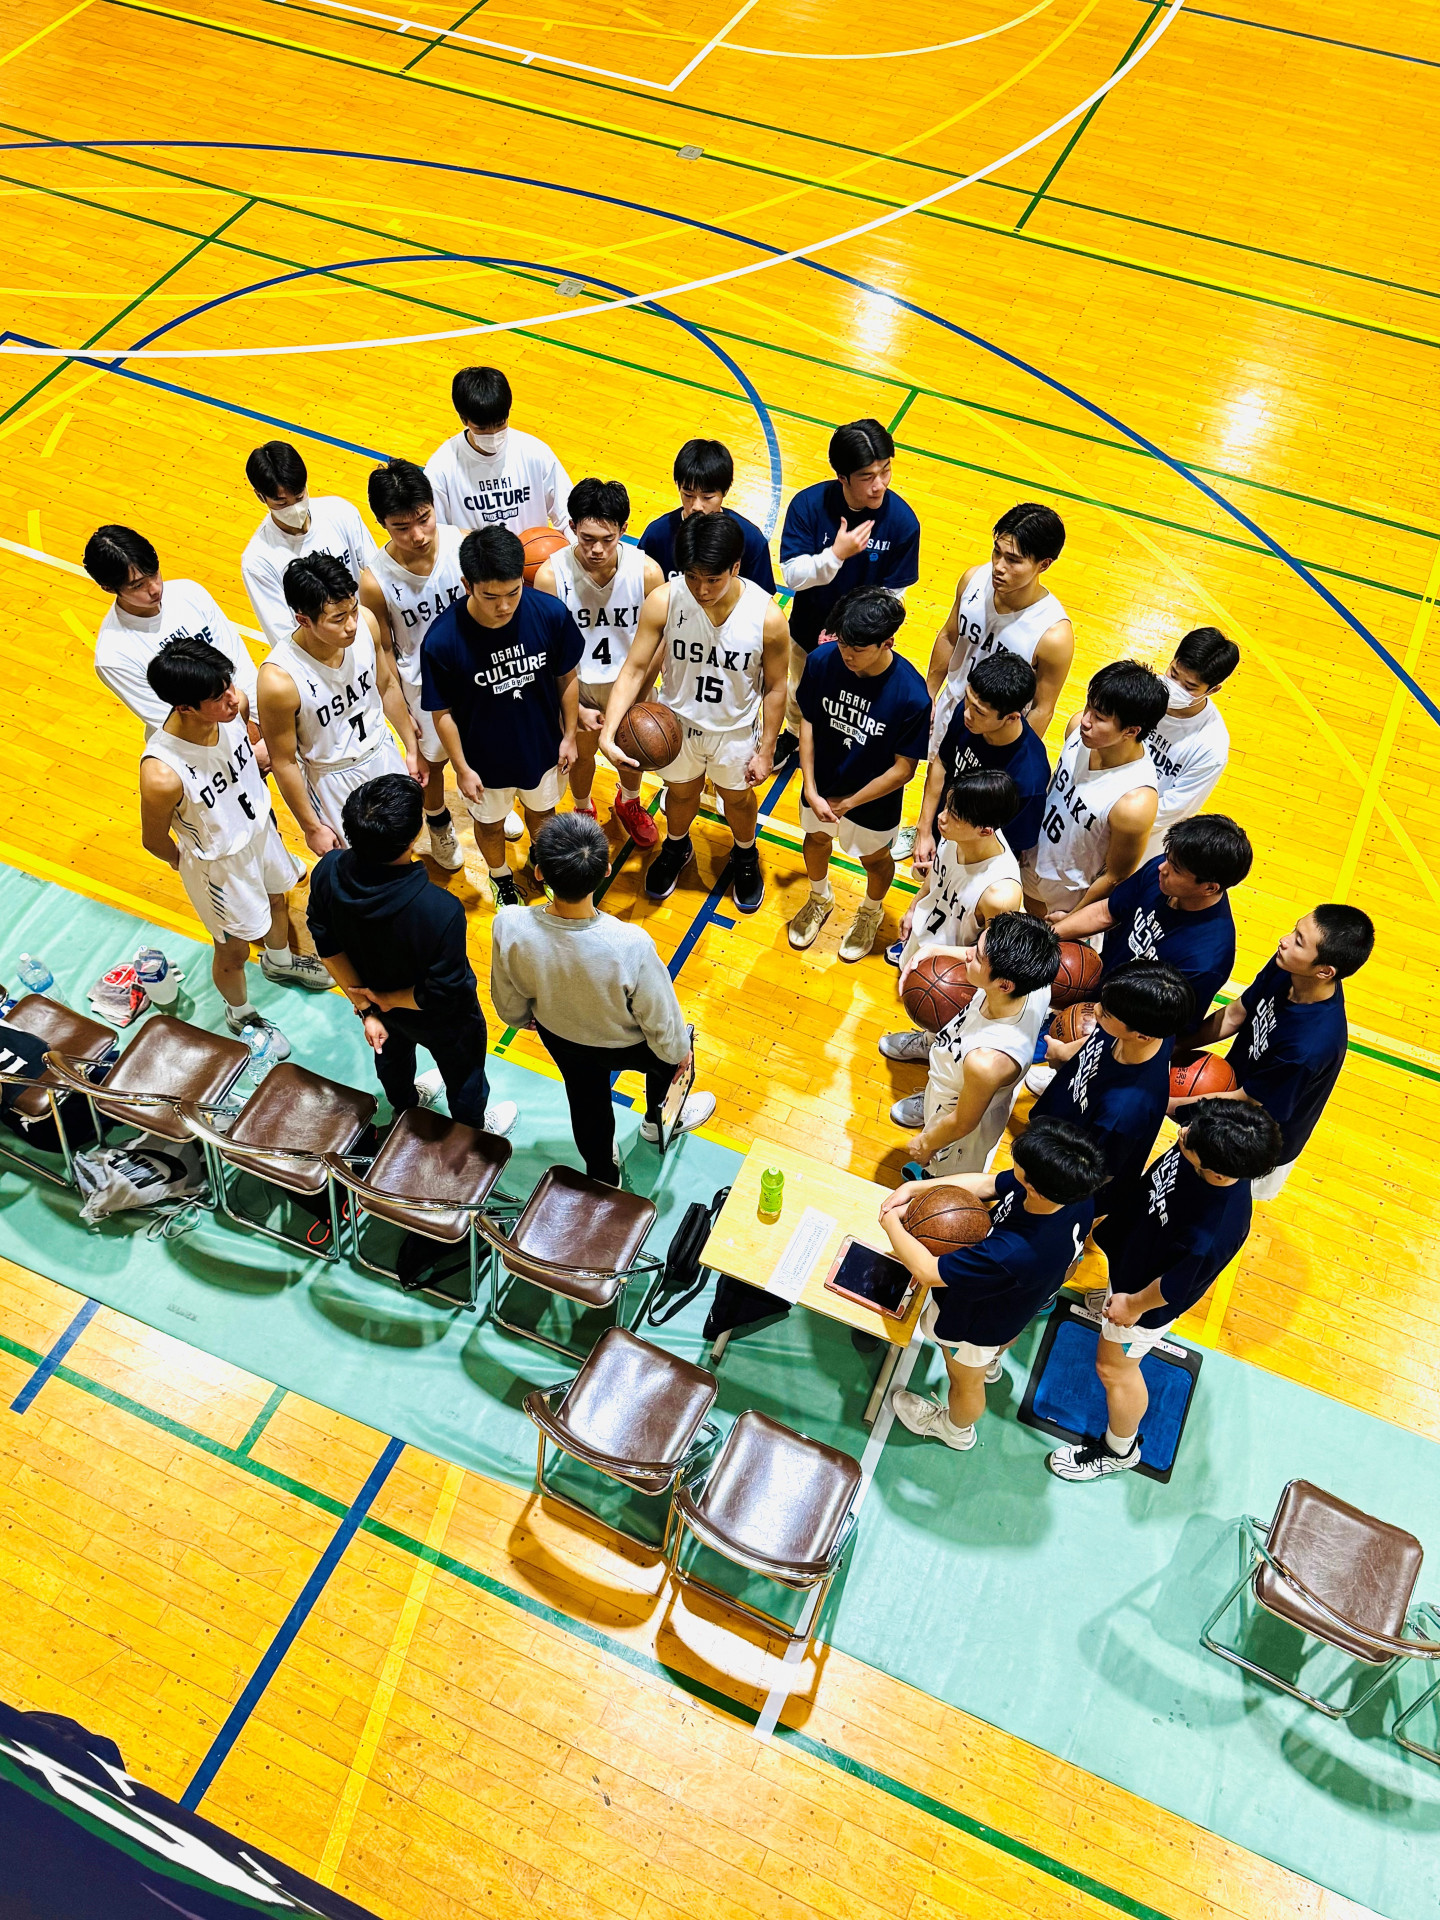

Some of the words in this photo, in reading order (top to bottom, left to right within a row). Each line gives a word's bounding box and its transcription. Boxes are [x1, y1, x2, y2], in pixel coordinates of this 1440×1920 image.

[464, 486, 530, 511] CULTURE
[479, 477, 512, 491] OSAKI
[867, 538, 891, 550] SAKI
[401, 585, 460, 627] OSAK
[572, 606, 639, 628] SAKI
[959, 614, 1010, 653] OSAK
[491, 643, 525, 664] OSAKI
[592, 637, 611, 664] 4
[673, 639, 752, 671] OSAKI
[474, 652, 547, 686] CULTURE
[316, 663, 374, 727] OSAK
[695, 676, 724, 703] 15
[839, 690, 871, 713] OSAKI
[348, 712, 367, 742] 7
[822, 697, 887, 736] CULTURE
[1148, 730, 1172, 753] SAKI
[200, 736, 254, 808] OSAKI
[1149, 744, 1182, 777] TURE
[1042, 804, 1065, 844] 16
[1156, 1149, 1173, 1227] ULTURE
